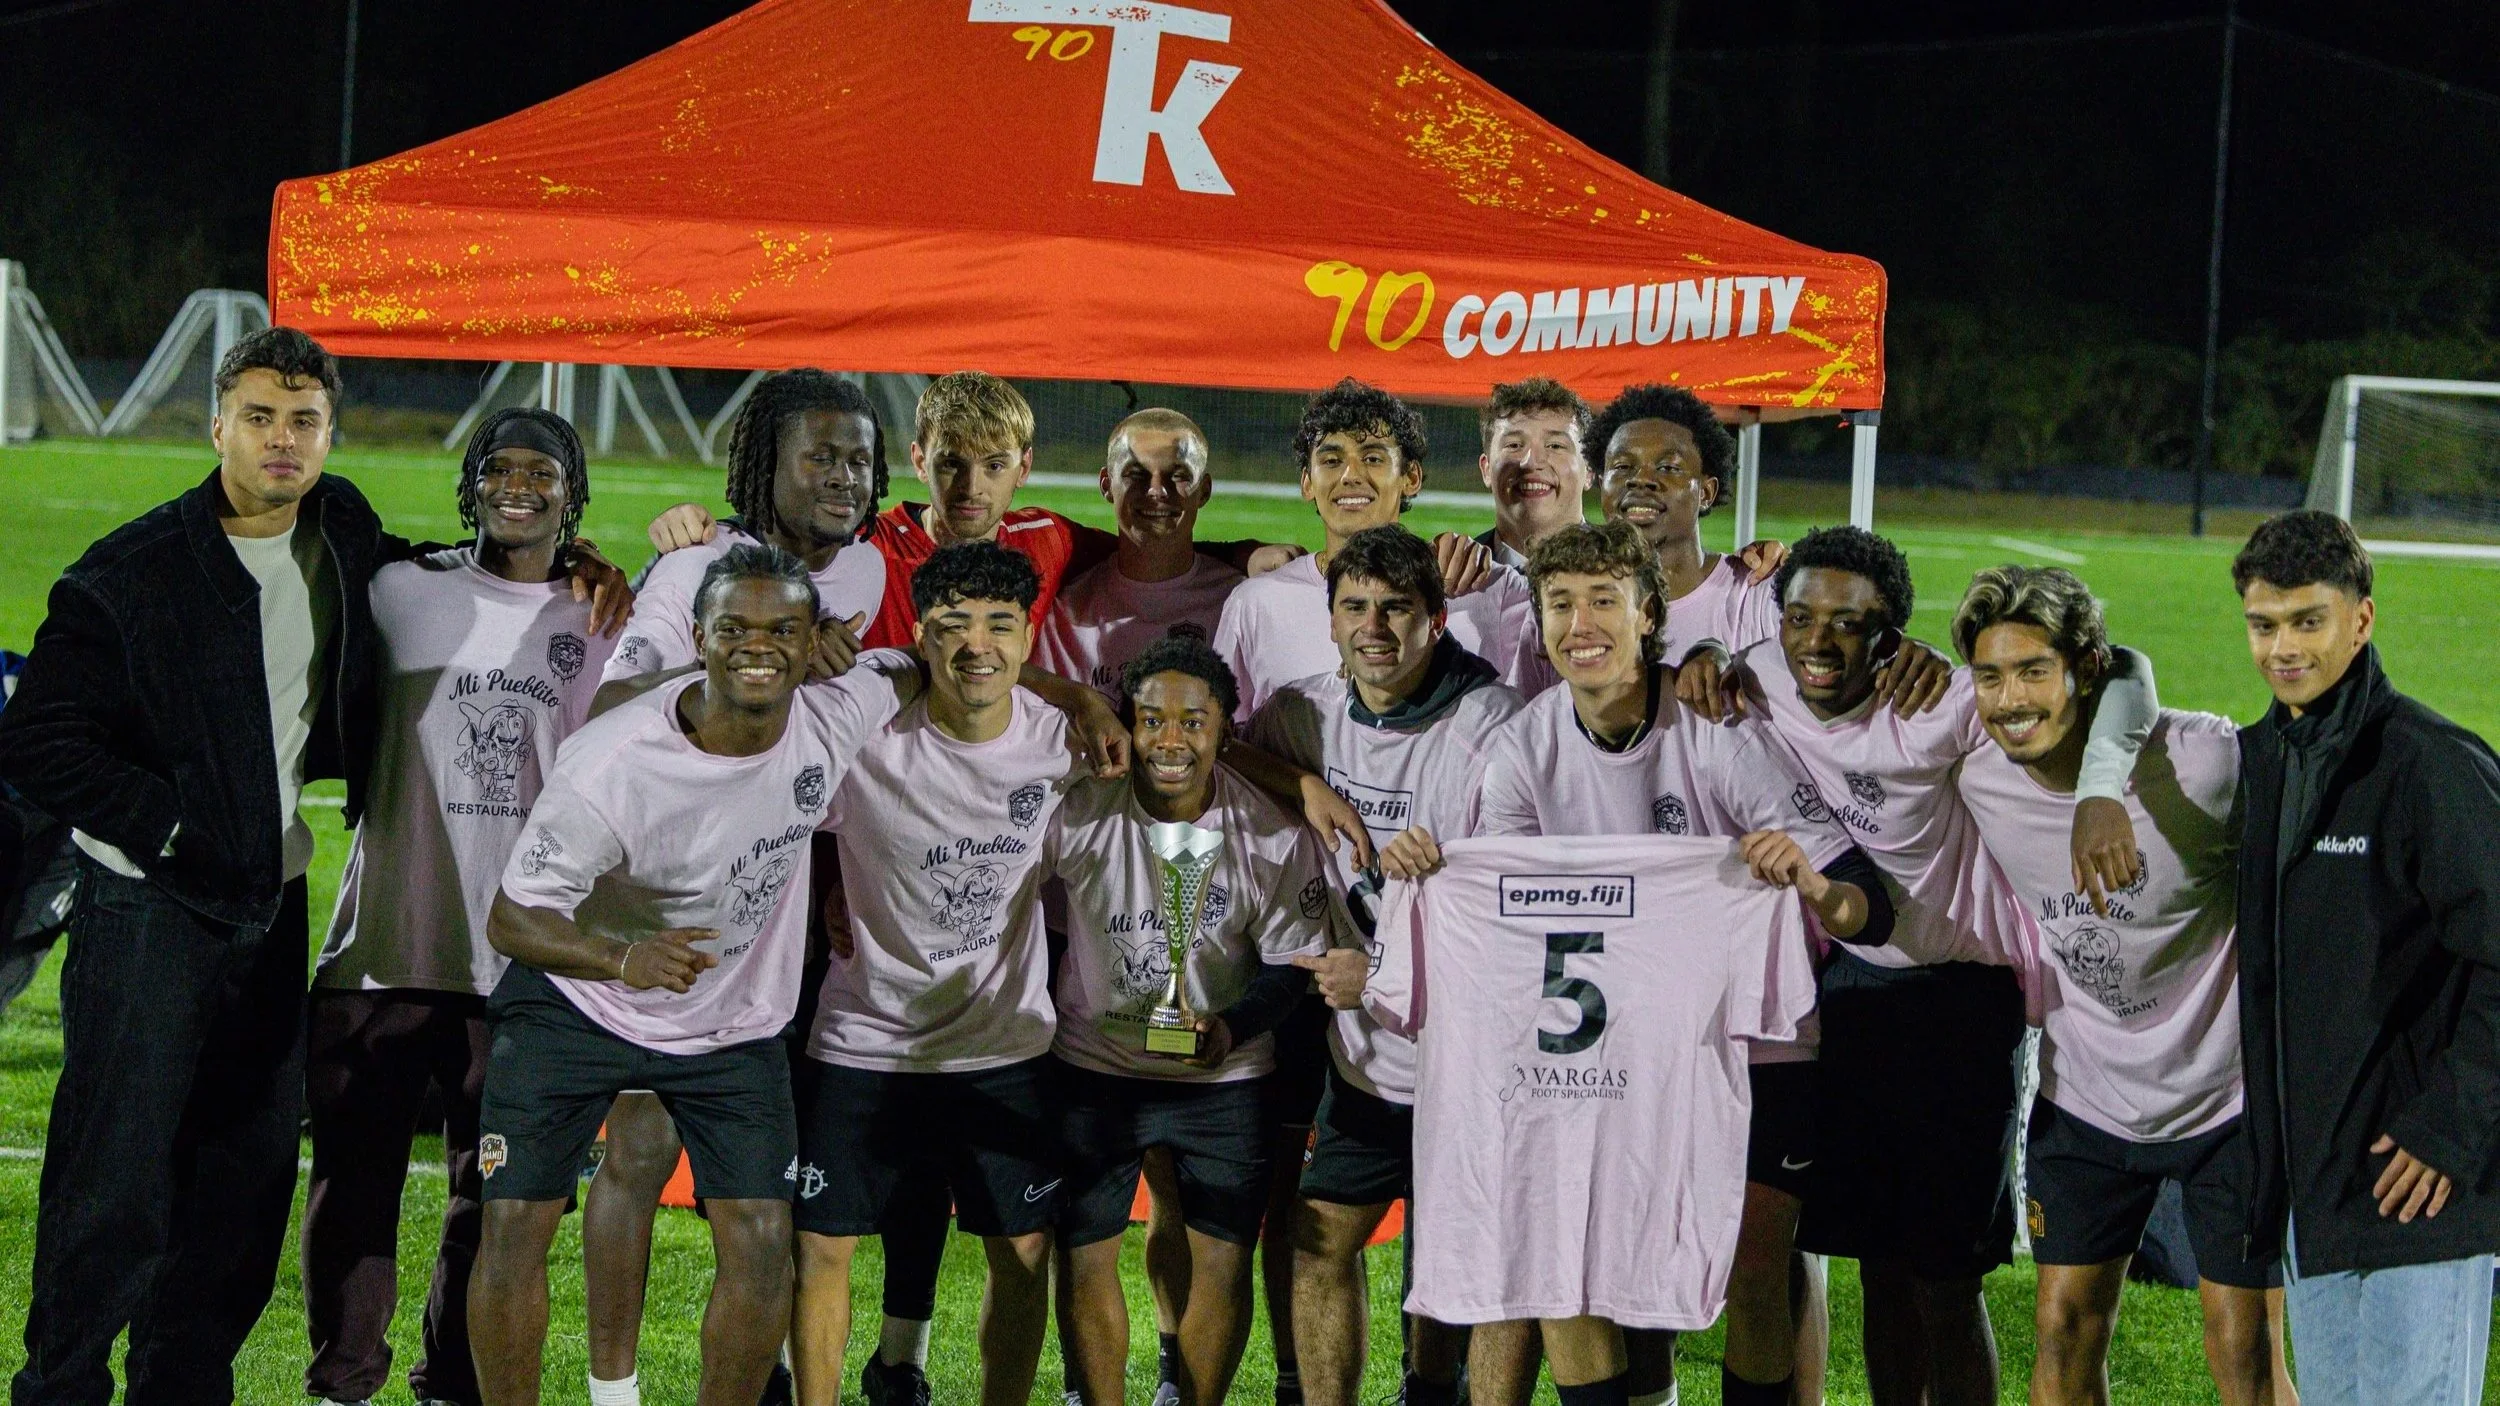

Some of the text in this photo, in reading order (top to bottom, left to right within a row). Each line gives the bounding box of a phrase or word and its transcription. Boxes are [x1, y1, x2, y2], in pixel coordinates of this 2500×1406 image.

[1012, 26, 1094, 61] 90
[1305, 261, 1806, 358] 90 COMMUNITY
[449, 668, 560, 708] Mi Pueblito
[725, 825, 814, 886] Mi Pueblito
[920, 834, 1026, 870] Mi Pueblito
[2313, 835, 2367, 855] ekker90
[1509, 885, 1624, 905] epmg.fiji
[2040, 895, 2059, 922] Mi
[1104, 913, 1133, 934] Mi
[1538, 932, 1607, 1054] 5
[1532, 1066, 1627, 1088] VARGAS
[1531, 1088, 1624, 1100] FOOT SPECIALISTS
